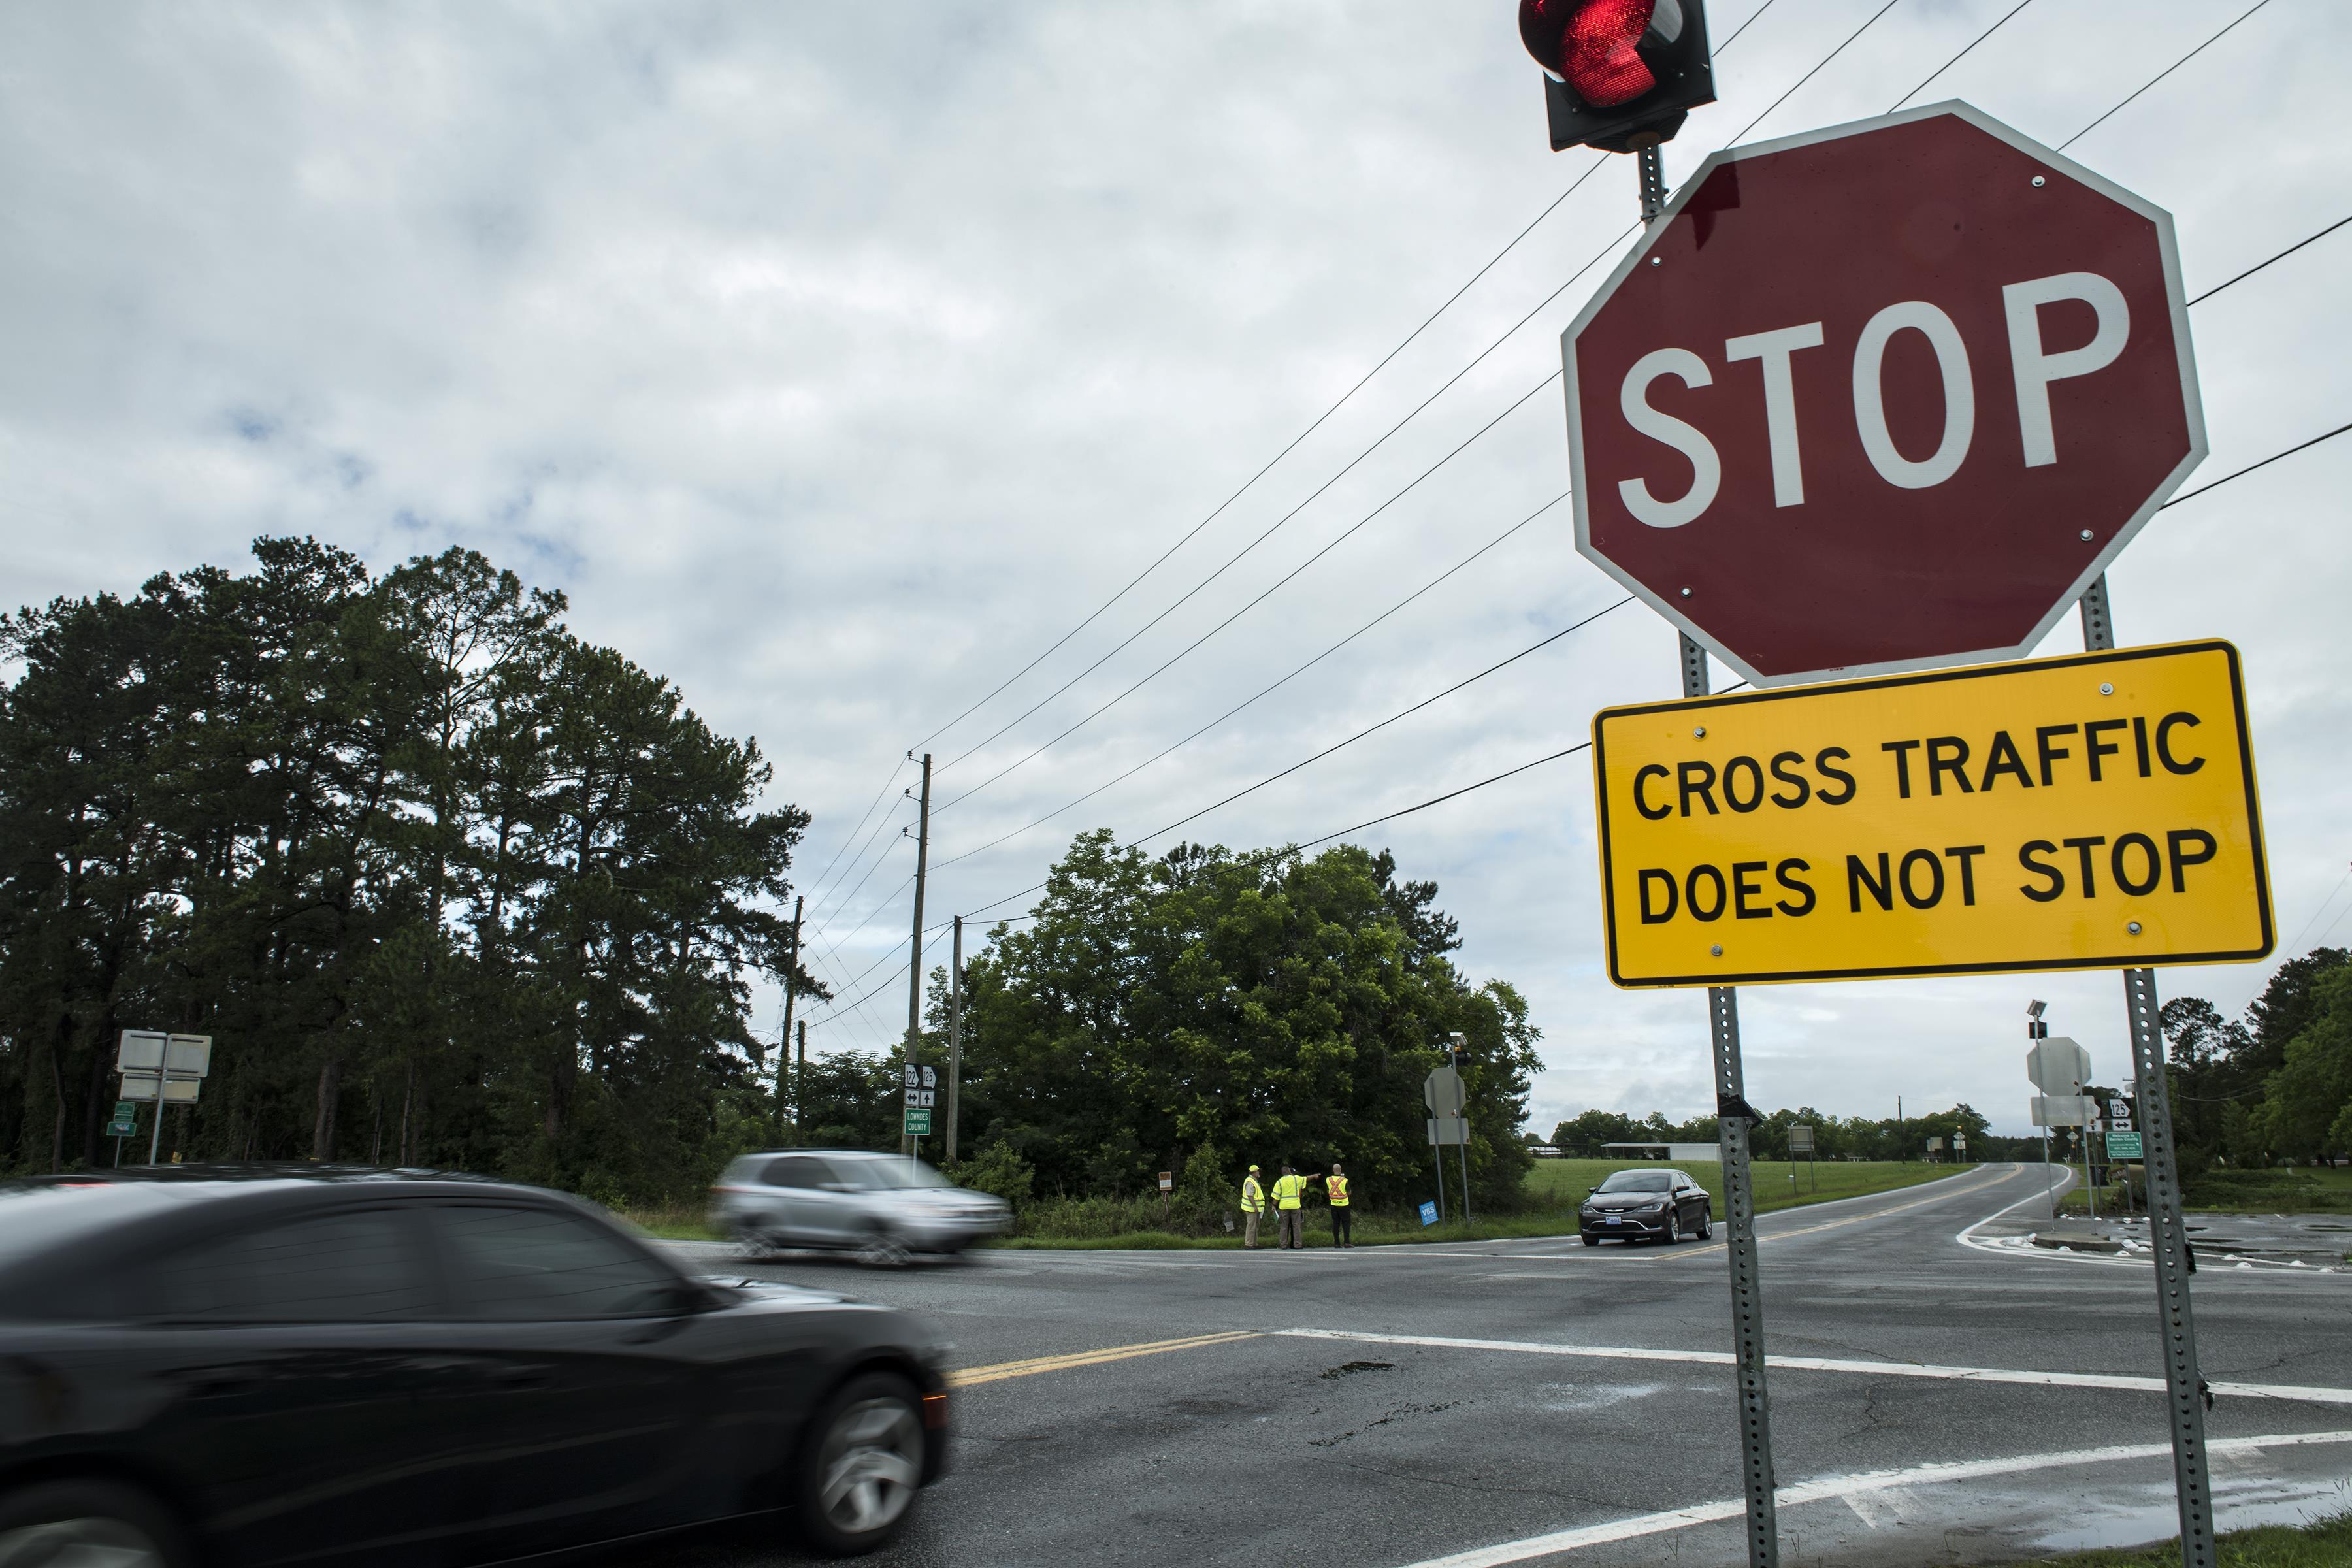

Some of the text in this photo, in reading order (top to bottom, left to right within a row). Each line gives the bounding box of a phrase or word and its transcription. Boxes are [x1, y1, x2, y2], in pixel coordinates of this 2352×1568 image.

[1618, 271, 2131, 529] STOP
[1633, 711, 2206, 821] CROSS TRAFFIC
[1638, 828, 2218, 925] DOES NOT STOP
[906, 1071, 916, 1085] 122
[924, 1071, 933, 1082] 125
[2112, 1104, 2126, 1115] 125
[908, 1122, 927, 1131] COUNTY
[1422, 1206, 1435, 1216] VBS
